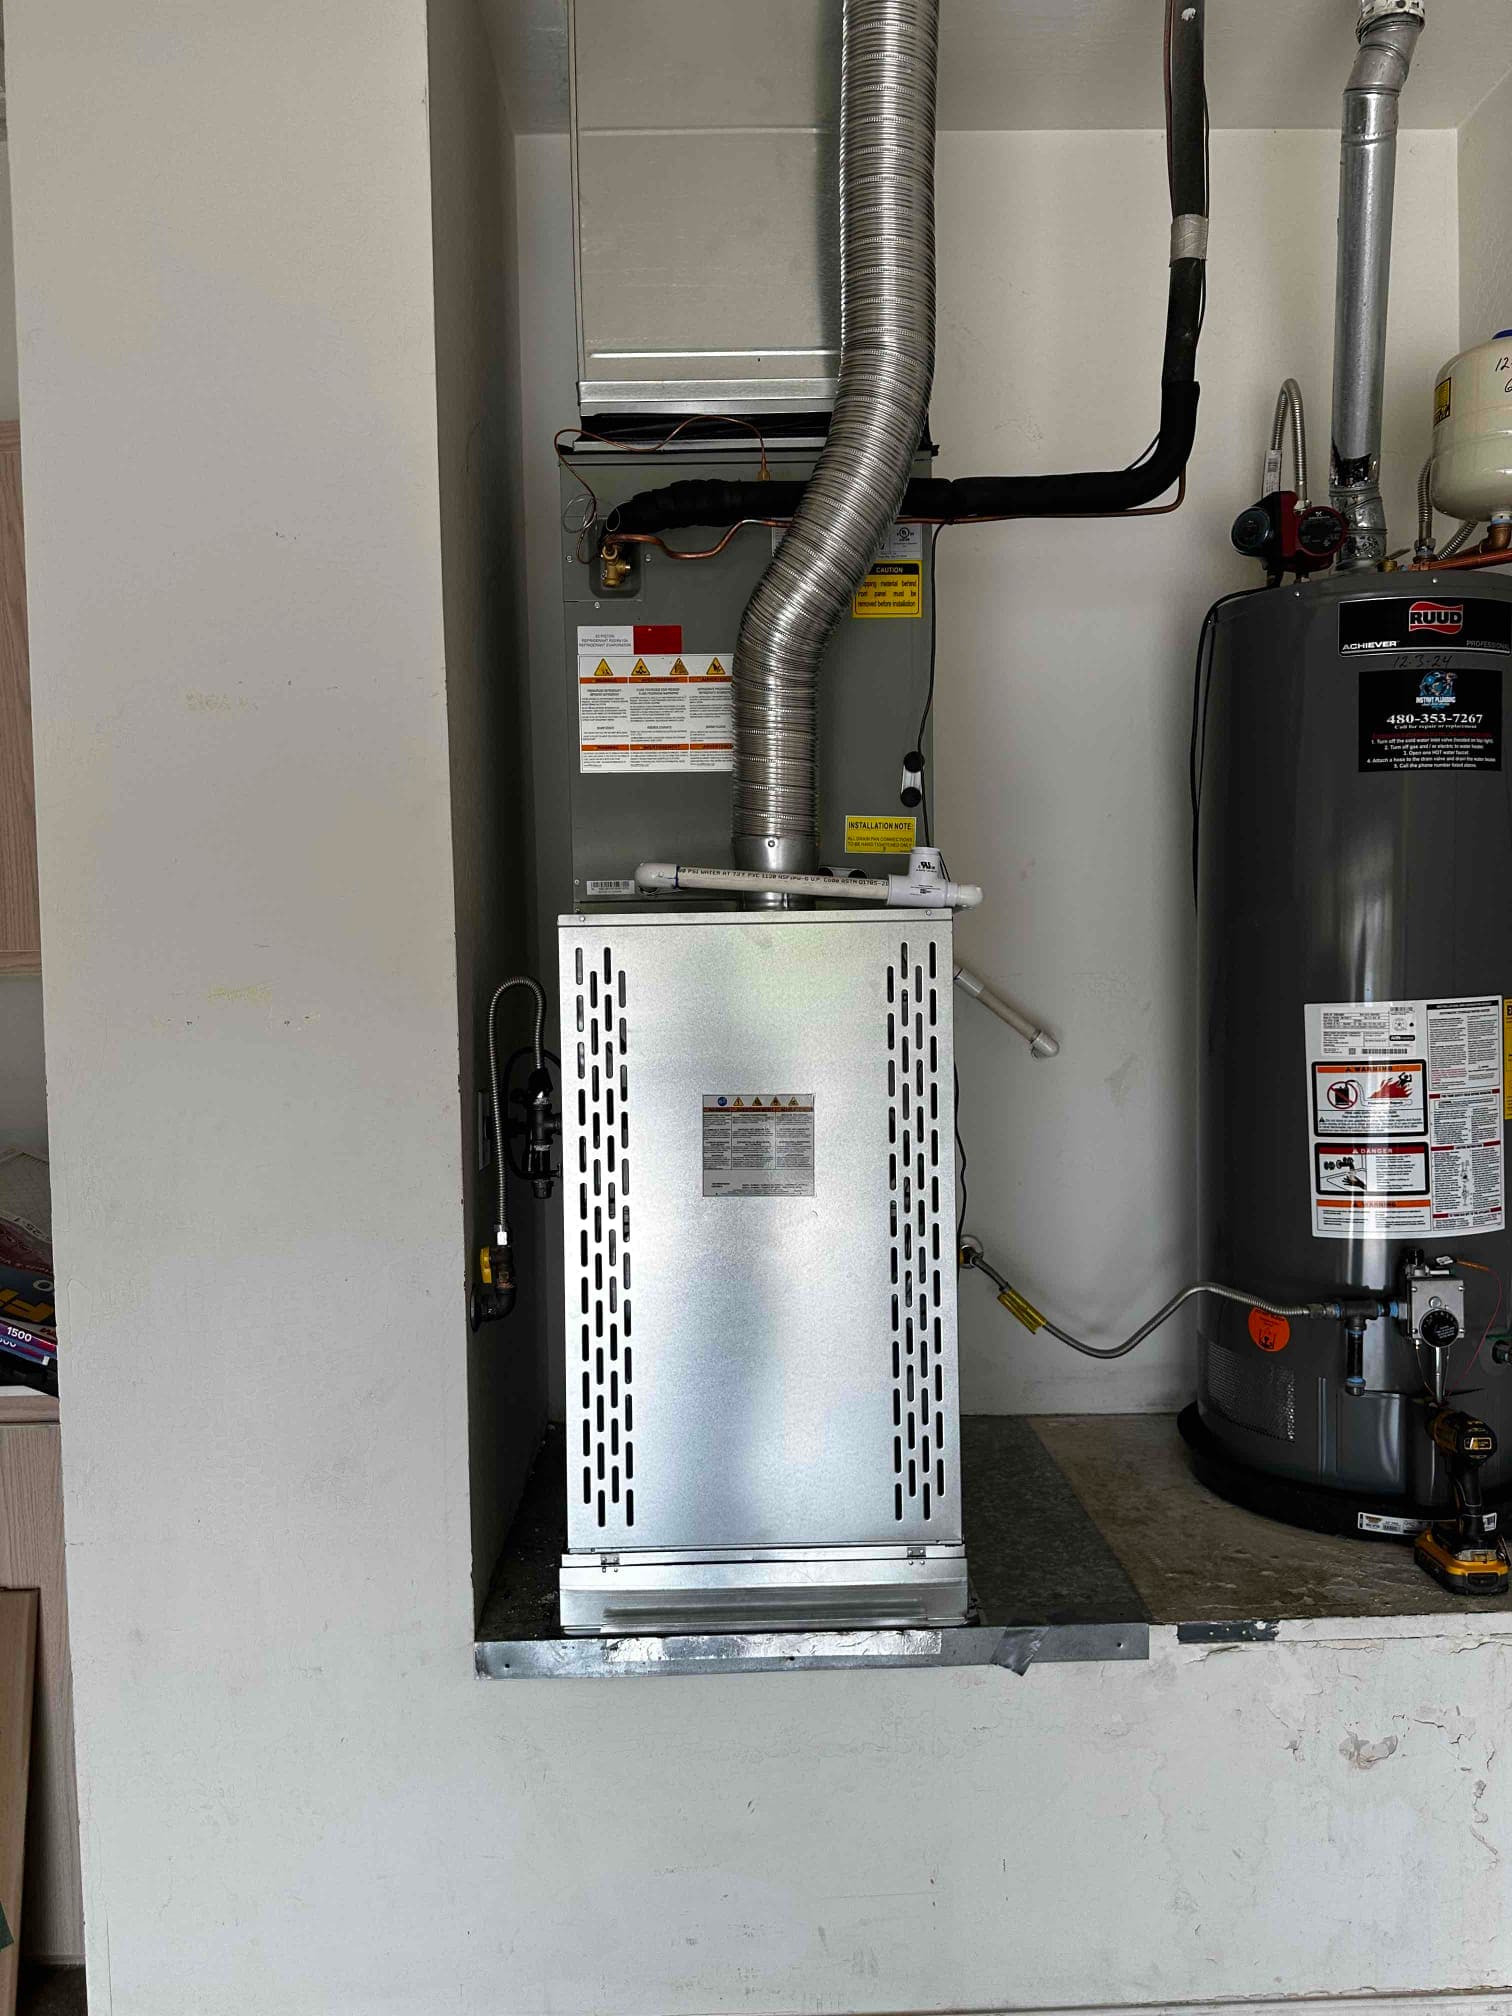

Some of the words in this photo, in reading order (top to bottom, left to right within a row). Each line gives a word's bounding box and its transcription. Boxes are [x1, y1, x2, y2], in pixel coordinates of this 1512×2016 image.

[876, 566, 903, 574] CAUTION
[1409, 611, 1462, 625] RUUD
[1342, 641, 1397, 651] ACHIEVER
[1386, 713, 1483, 724] 480-353-7267
[848, 821, 893, 830] INSTALLATION
[1354, 1065, 1393, 1073] WARNING
[7, 1326, 32, 1343] 1500
